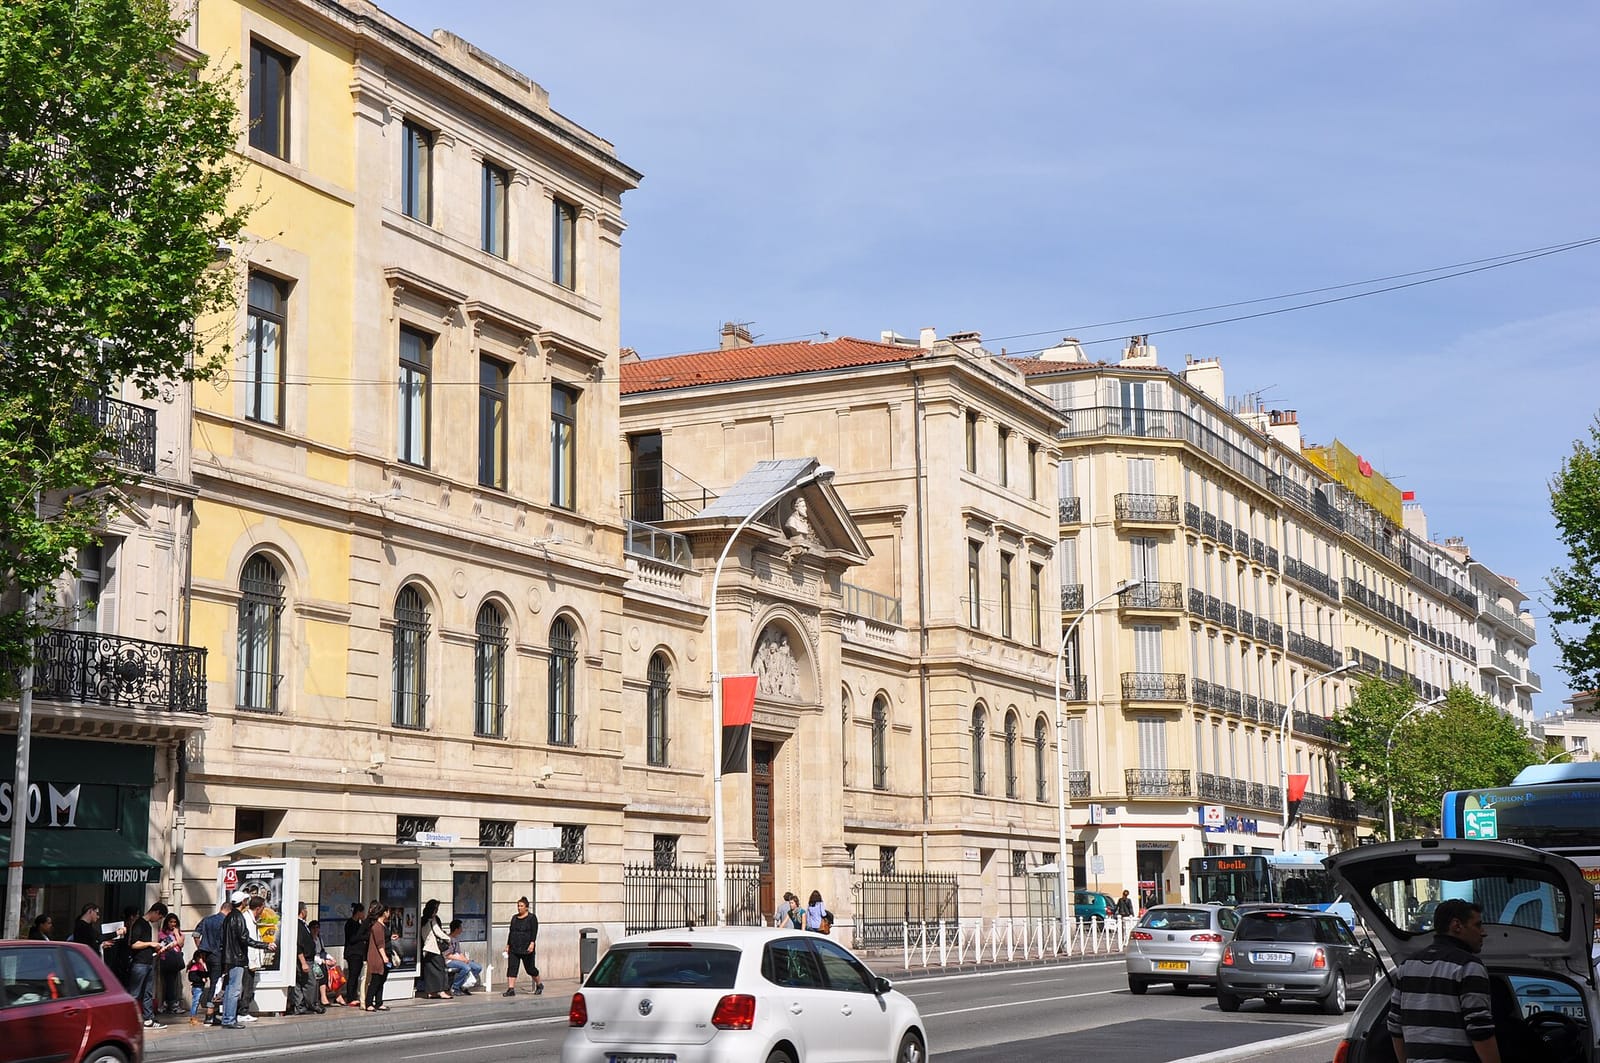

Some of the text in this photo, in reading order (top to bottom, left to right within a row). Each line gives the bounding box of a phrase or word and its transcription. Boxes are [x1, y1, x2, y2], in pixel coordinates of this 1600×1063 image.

[0, 782, 42, 823] SO
[426, 833, 452, 843] Strasbourg
[1203, 860, 1208, 870] 5
[102, 868, 138, 883] MEPHISTO
